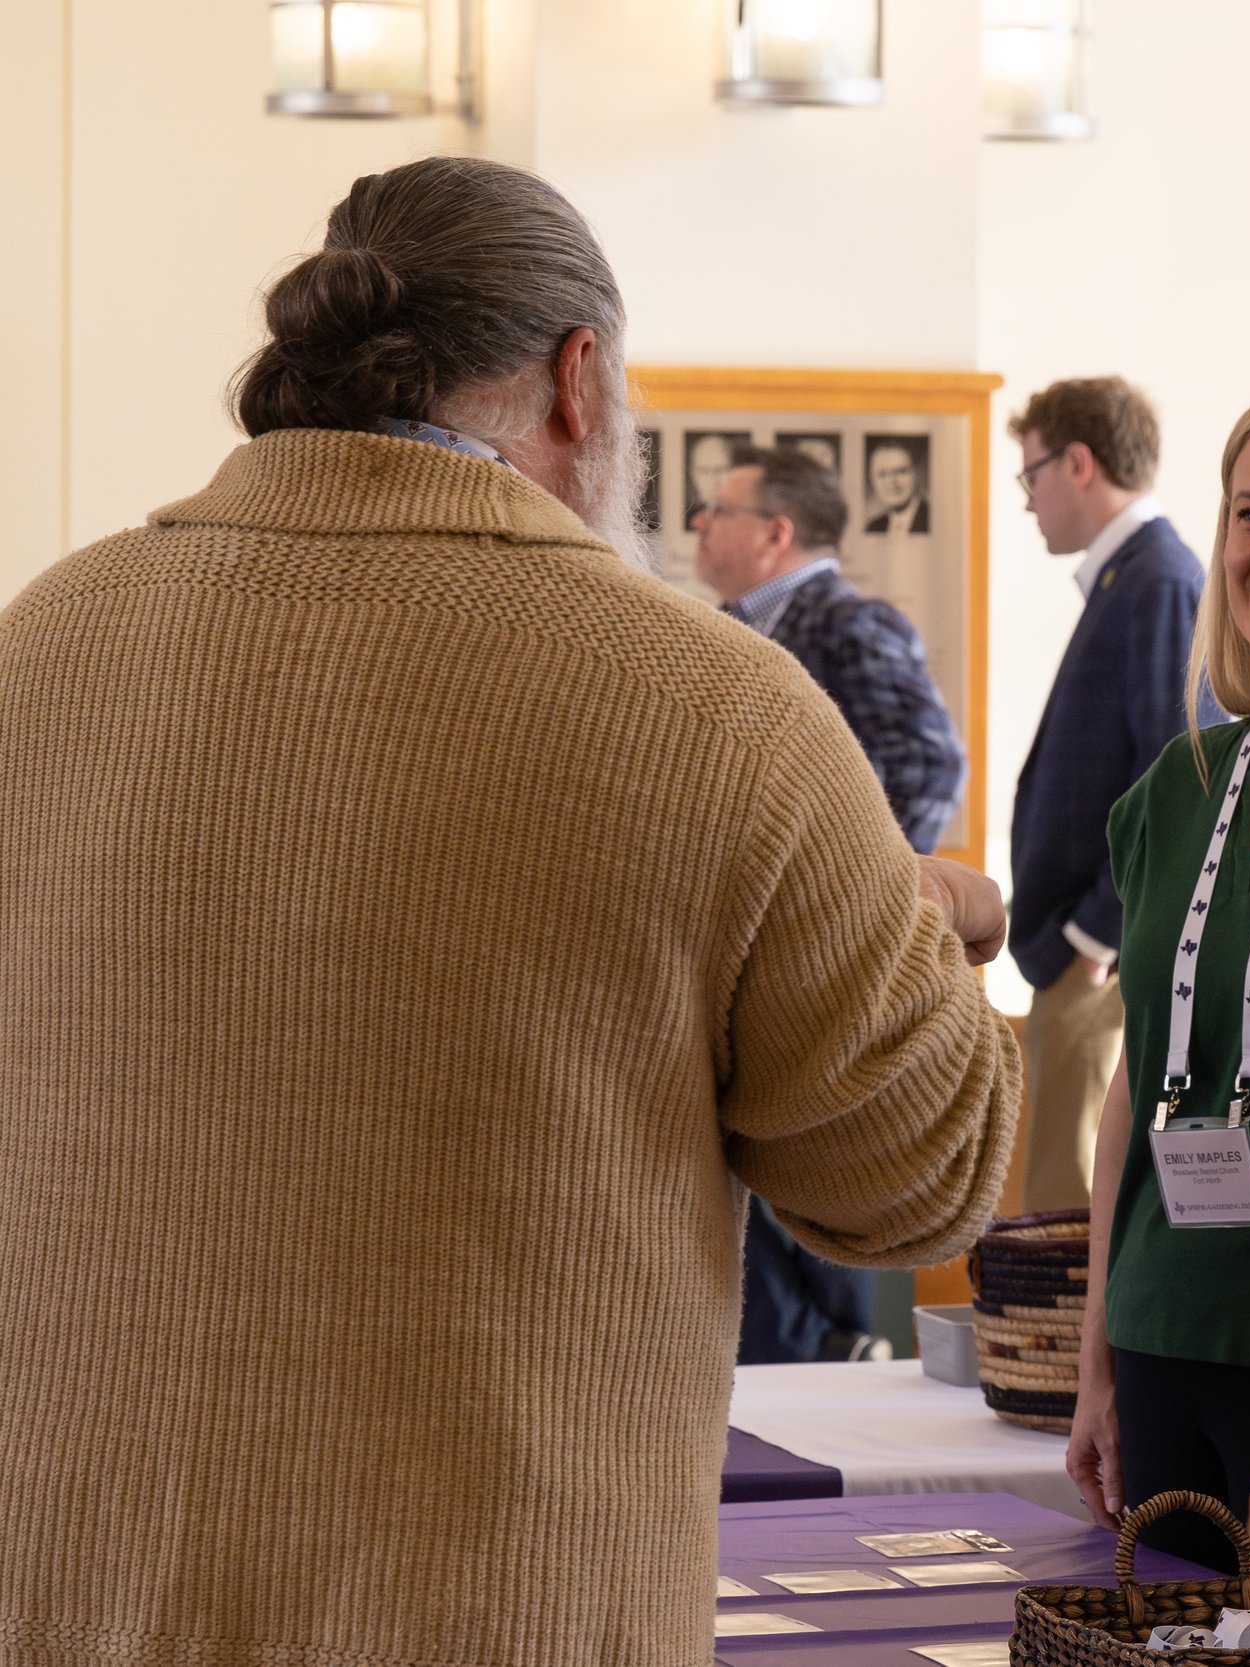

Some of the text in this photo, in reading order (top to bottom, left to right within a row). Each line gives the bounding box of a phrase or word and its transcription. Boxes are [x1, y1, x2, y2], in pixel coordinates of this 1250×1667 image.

[1164, 1151, 1242, 1164] EMILY MAPLES
[1199, 1168, 1218, 1176] Baptist
[1219, 1167, 1240, 1175] Church
